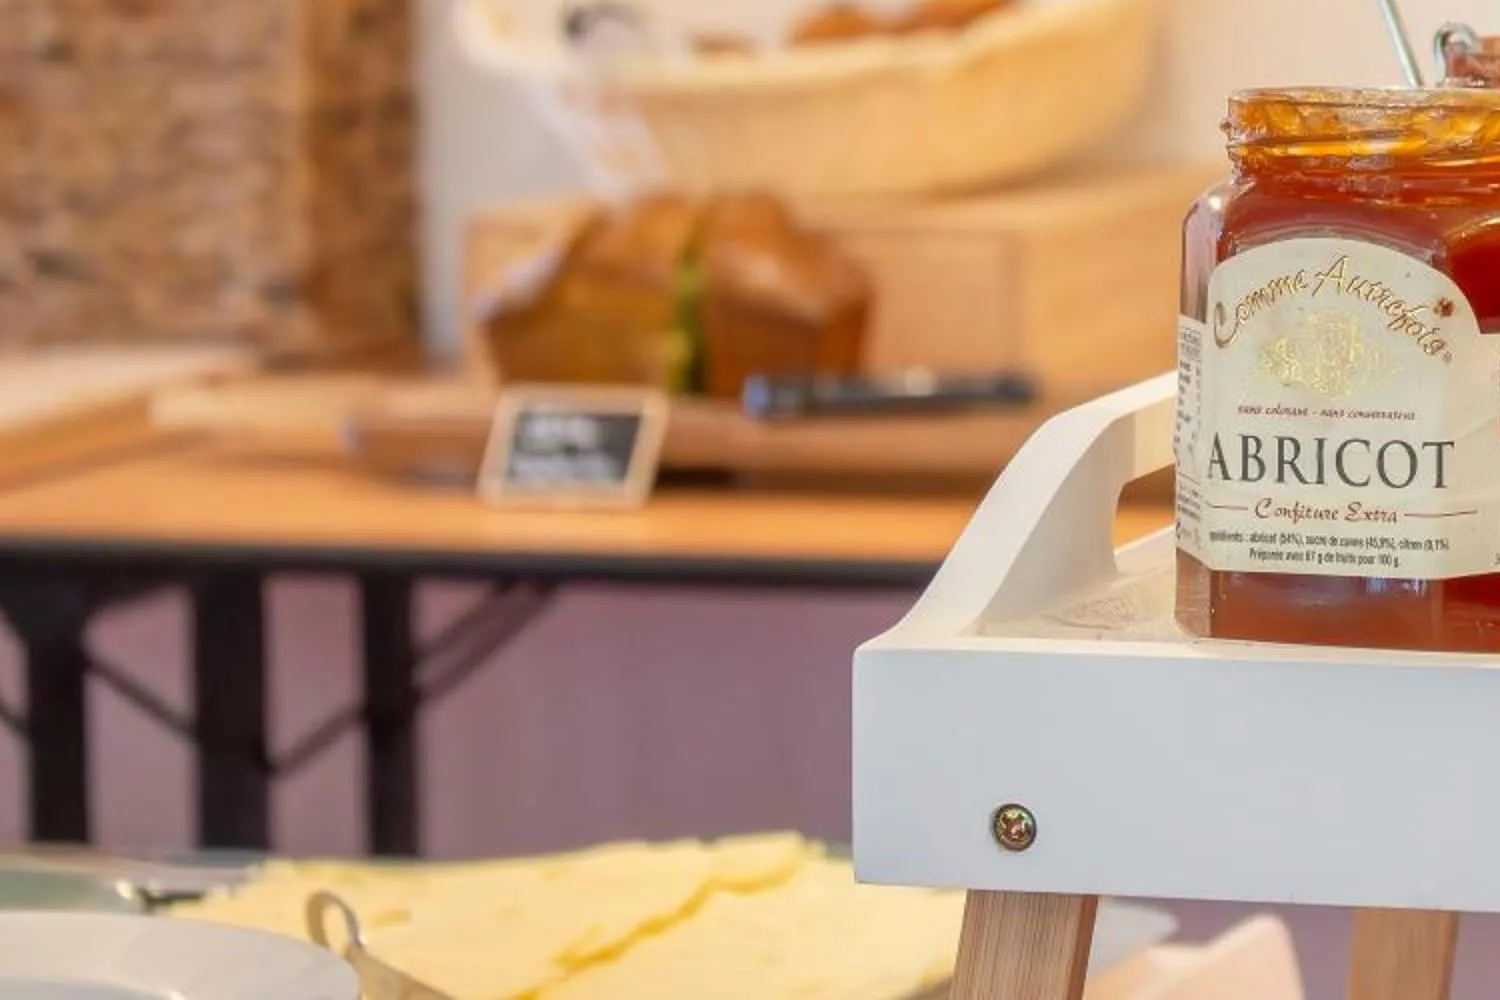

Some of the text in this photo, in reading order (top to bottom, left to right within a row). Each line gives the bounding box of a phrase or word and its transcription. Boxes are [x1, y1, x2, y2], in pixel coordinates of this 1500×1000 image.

[1213, 255, 1445, 355] Comme Autrefois
[1207, 431, 1455, 489] ABRICOT
[1255, 498, 1398, 524] Confiture Extra
